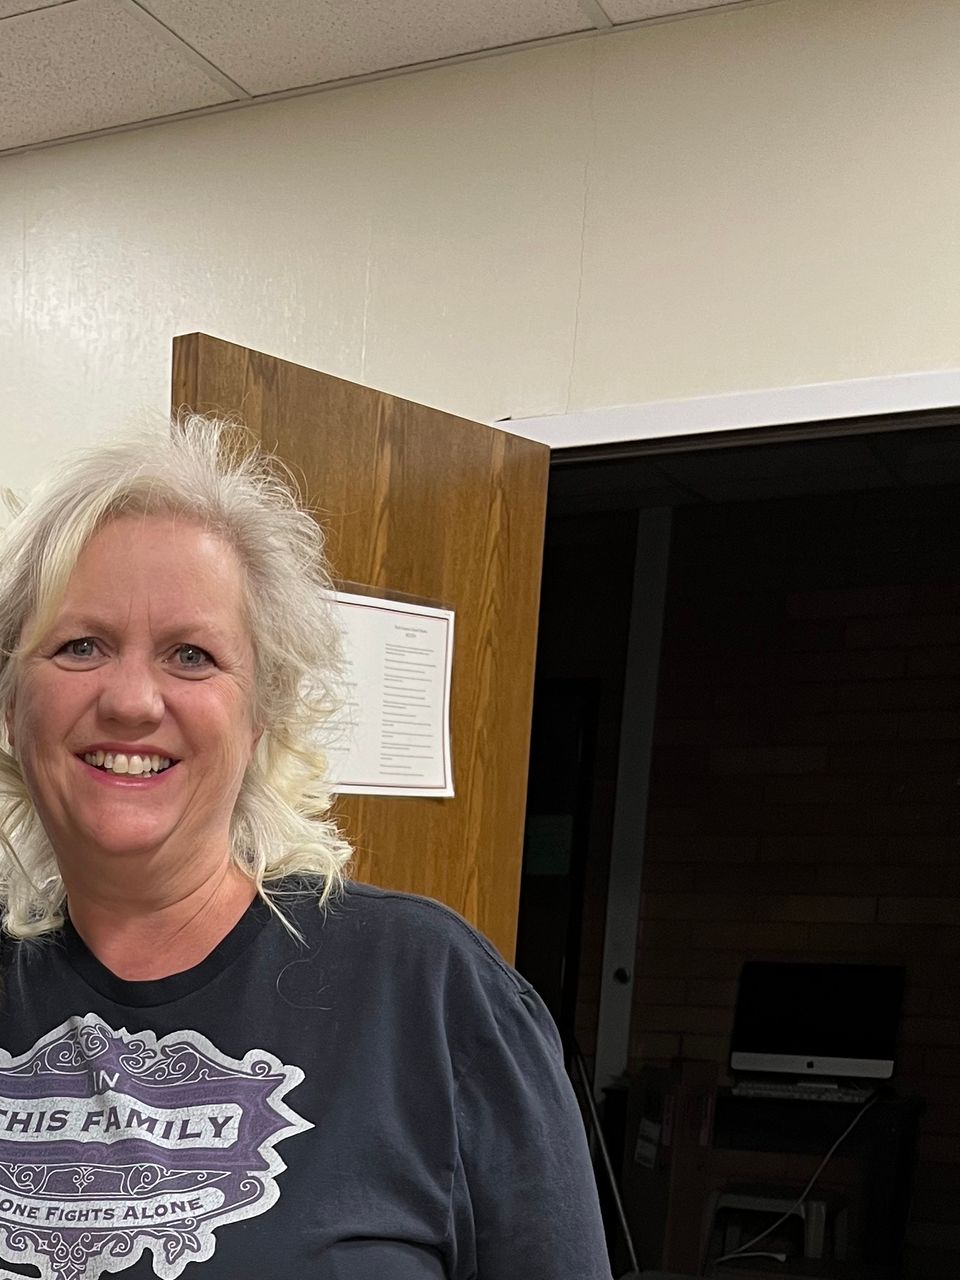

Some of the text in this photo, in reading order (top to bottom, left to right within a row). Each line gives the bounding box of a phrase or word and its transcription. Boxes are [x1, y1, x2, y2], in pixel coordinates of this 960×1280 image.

[93, 1071, 120, 1091] IN
[81, 1106, 234, 1140] FAMILY
[45, 1207, 115, 1222] FIGHTS
[122, 1197, 204, 1220] ALONE
